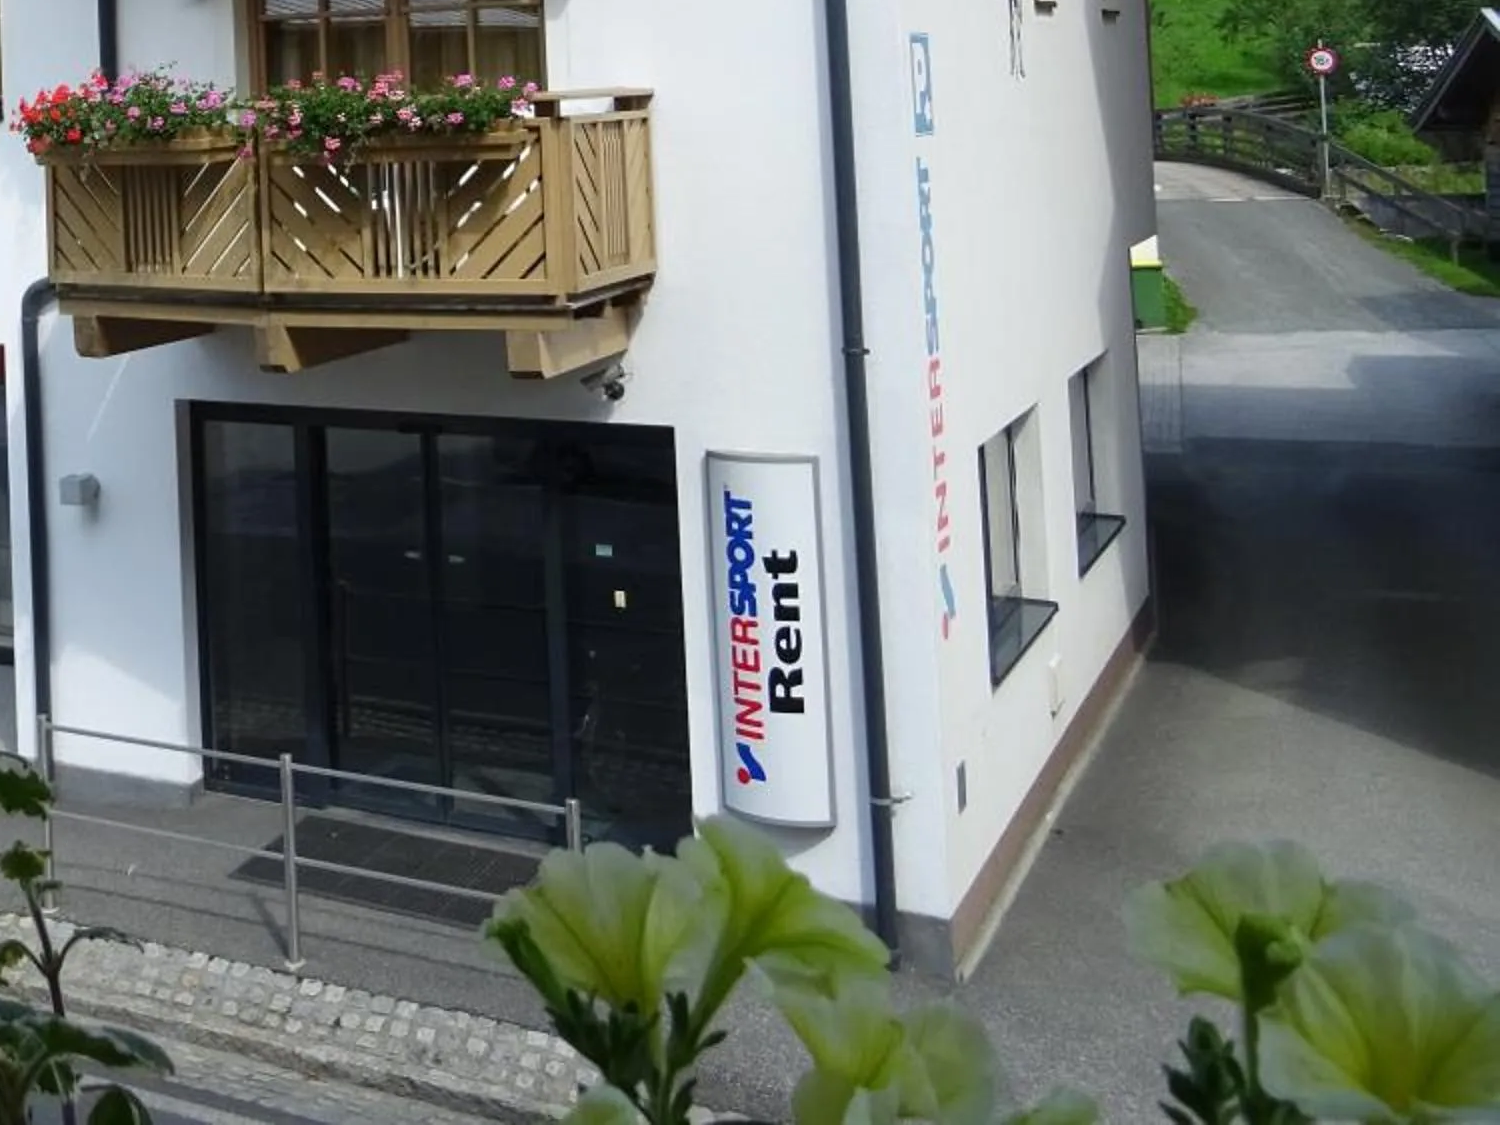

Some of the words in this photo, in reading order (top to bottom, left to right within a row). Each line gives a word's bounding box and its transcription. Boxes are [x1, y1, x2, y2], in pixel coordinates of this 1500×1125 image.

[915, 156, 952, 553] INTERSPORT
[725, 490, 765, 740] INTERSPORT
[762, 549, 805, 714] Rent
